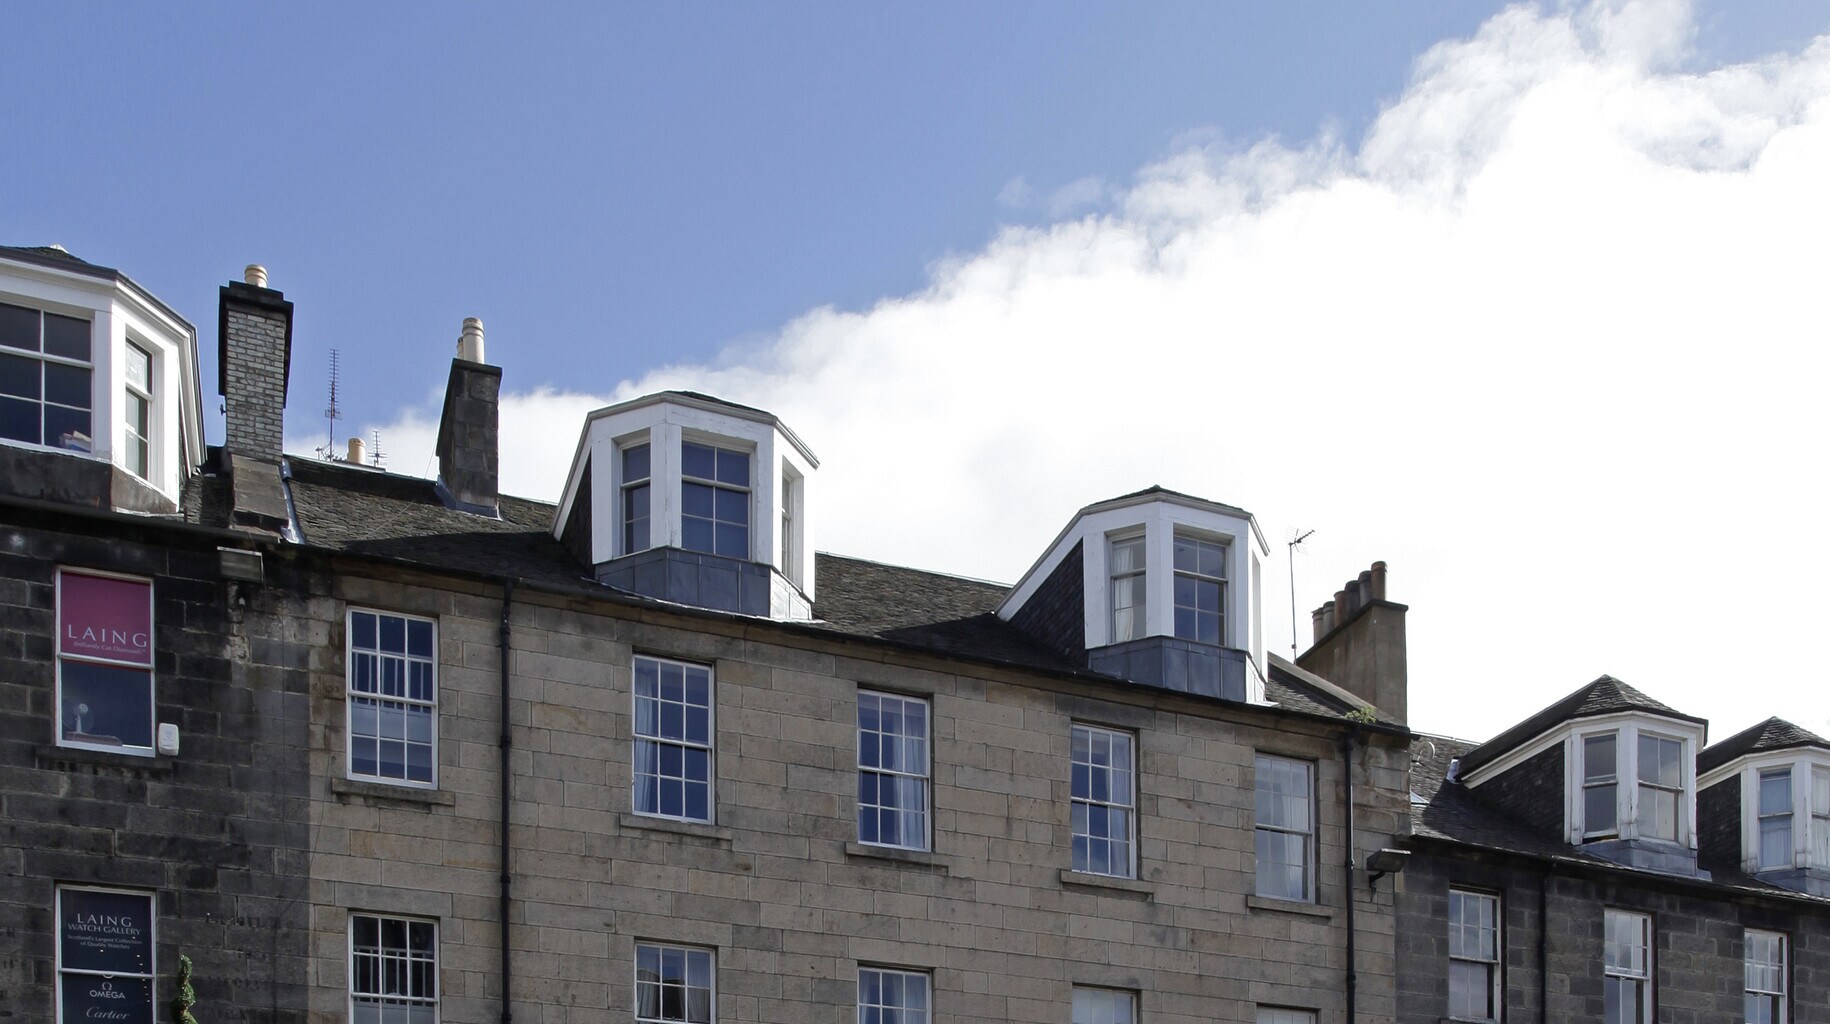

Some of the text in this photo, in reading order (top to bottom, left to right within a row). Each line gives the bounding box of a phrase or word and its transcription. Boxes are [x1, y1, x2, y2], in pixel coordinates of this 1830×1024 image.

[68, 624, 147, 648] LAING
[77, 913, 132, 927] LAING
[67, 923, 141, 935] WATCH GALLERY
[89, 989, 126, 999] OMEGA
[86, 1006, 130, 1020] Cartier
